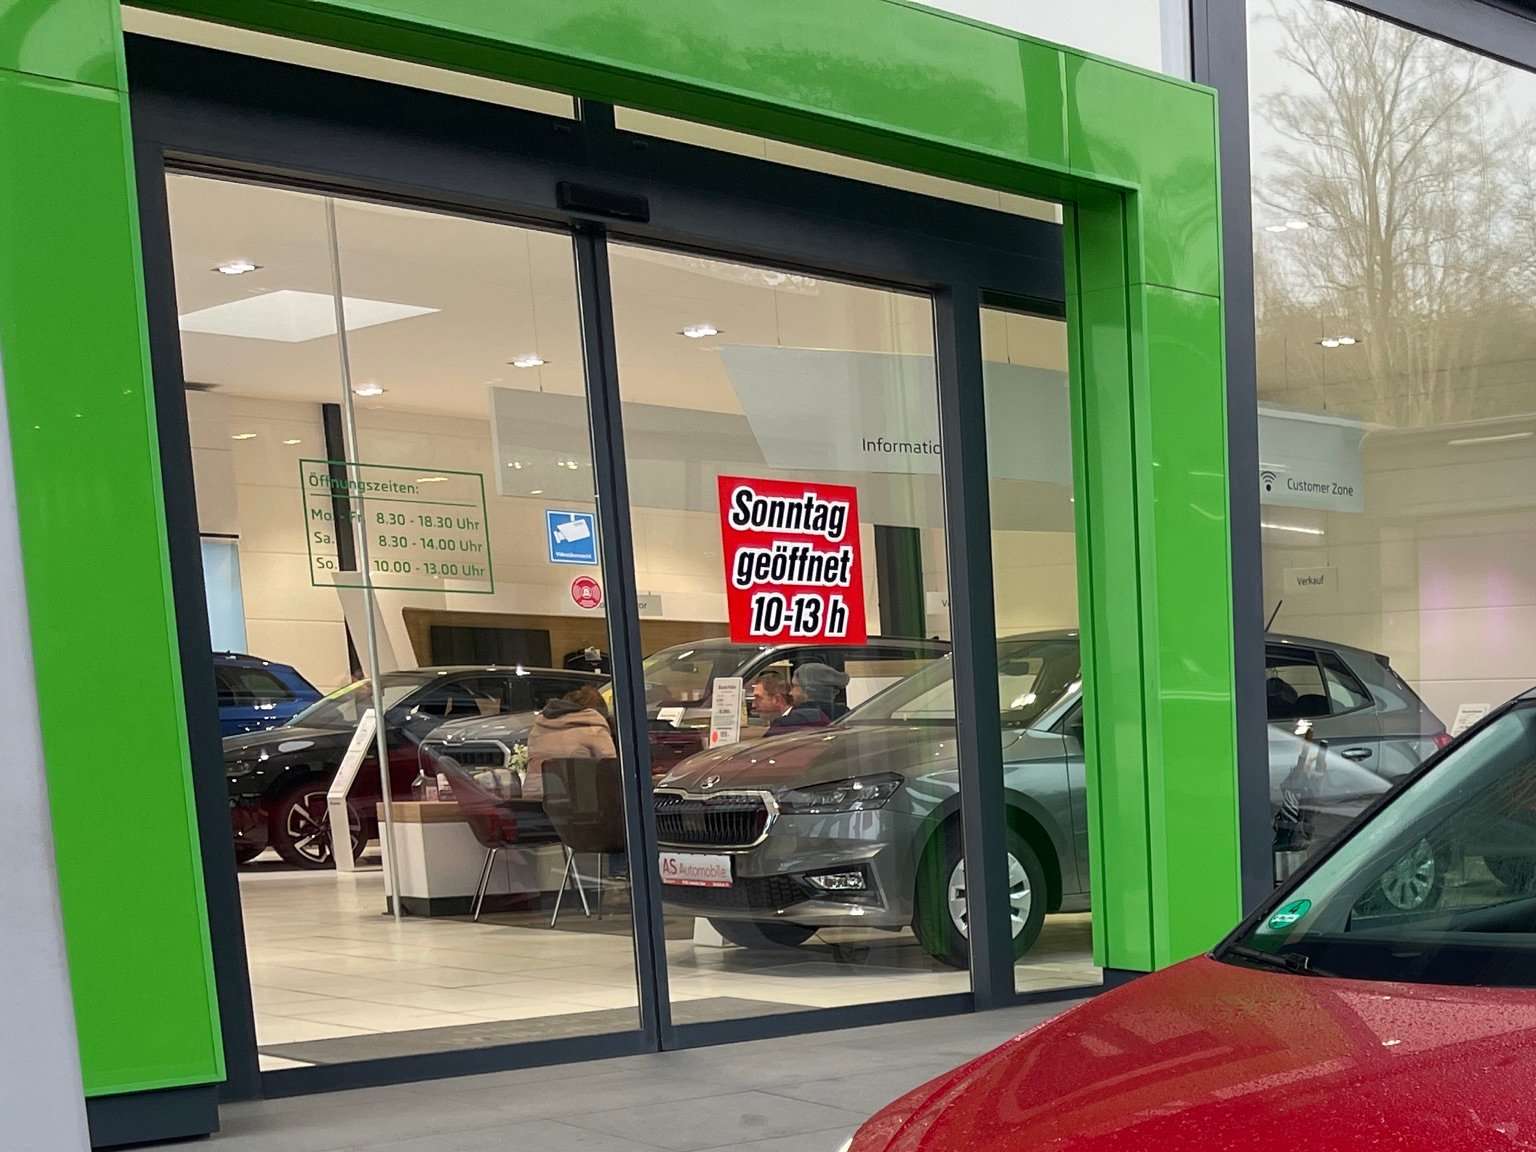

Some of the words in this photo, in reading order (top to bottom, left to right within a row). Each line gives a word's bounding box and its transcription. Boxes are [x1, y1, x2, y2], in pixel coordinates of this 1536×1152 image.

[308, 473, 419, 494] Öffnungszeiten:
[1287, 478, 1330, 494] Customer
[1331, 482, 1354, 496] Zone
[376, 512, 406, 526] 8.30
[418, 515, 453, 529] 18.30
[457, 517, 480, 531] Uhr
[731, 488, 848, 540] Sonntag
[313, 531, 335, 545] Sa.
[379, 535, 408, 549] 8.30
[420, 537, 456, 551] 14.00
[460, 540, 483, 553] Uhr
[316, 557, 338, 570] So.
[374, 560, 411, 574] 10.00
[423, 562, 458, 576] 13.00
[462, 564, 486, 578] Uhr
[735, 545, 851, 586] geöffnet
[1296, 575, 1325, 587] Verkauf
[753, 595, 821, 633] 10-13
[828, 598, 846, 633] h
[663, 857, 678, 875] AS
